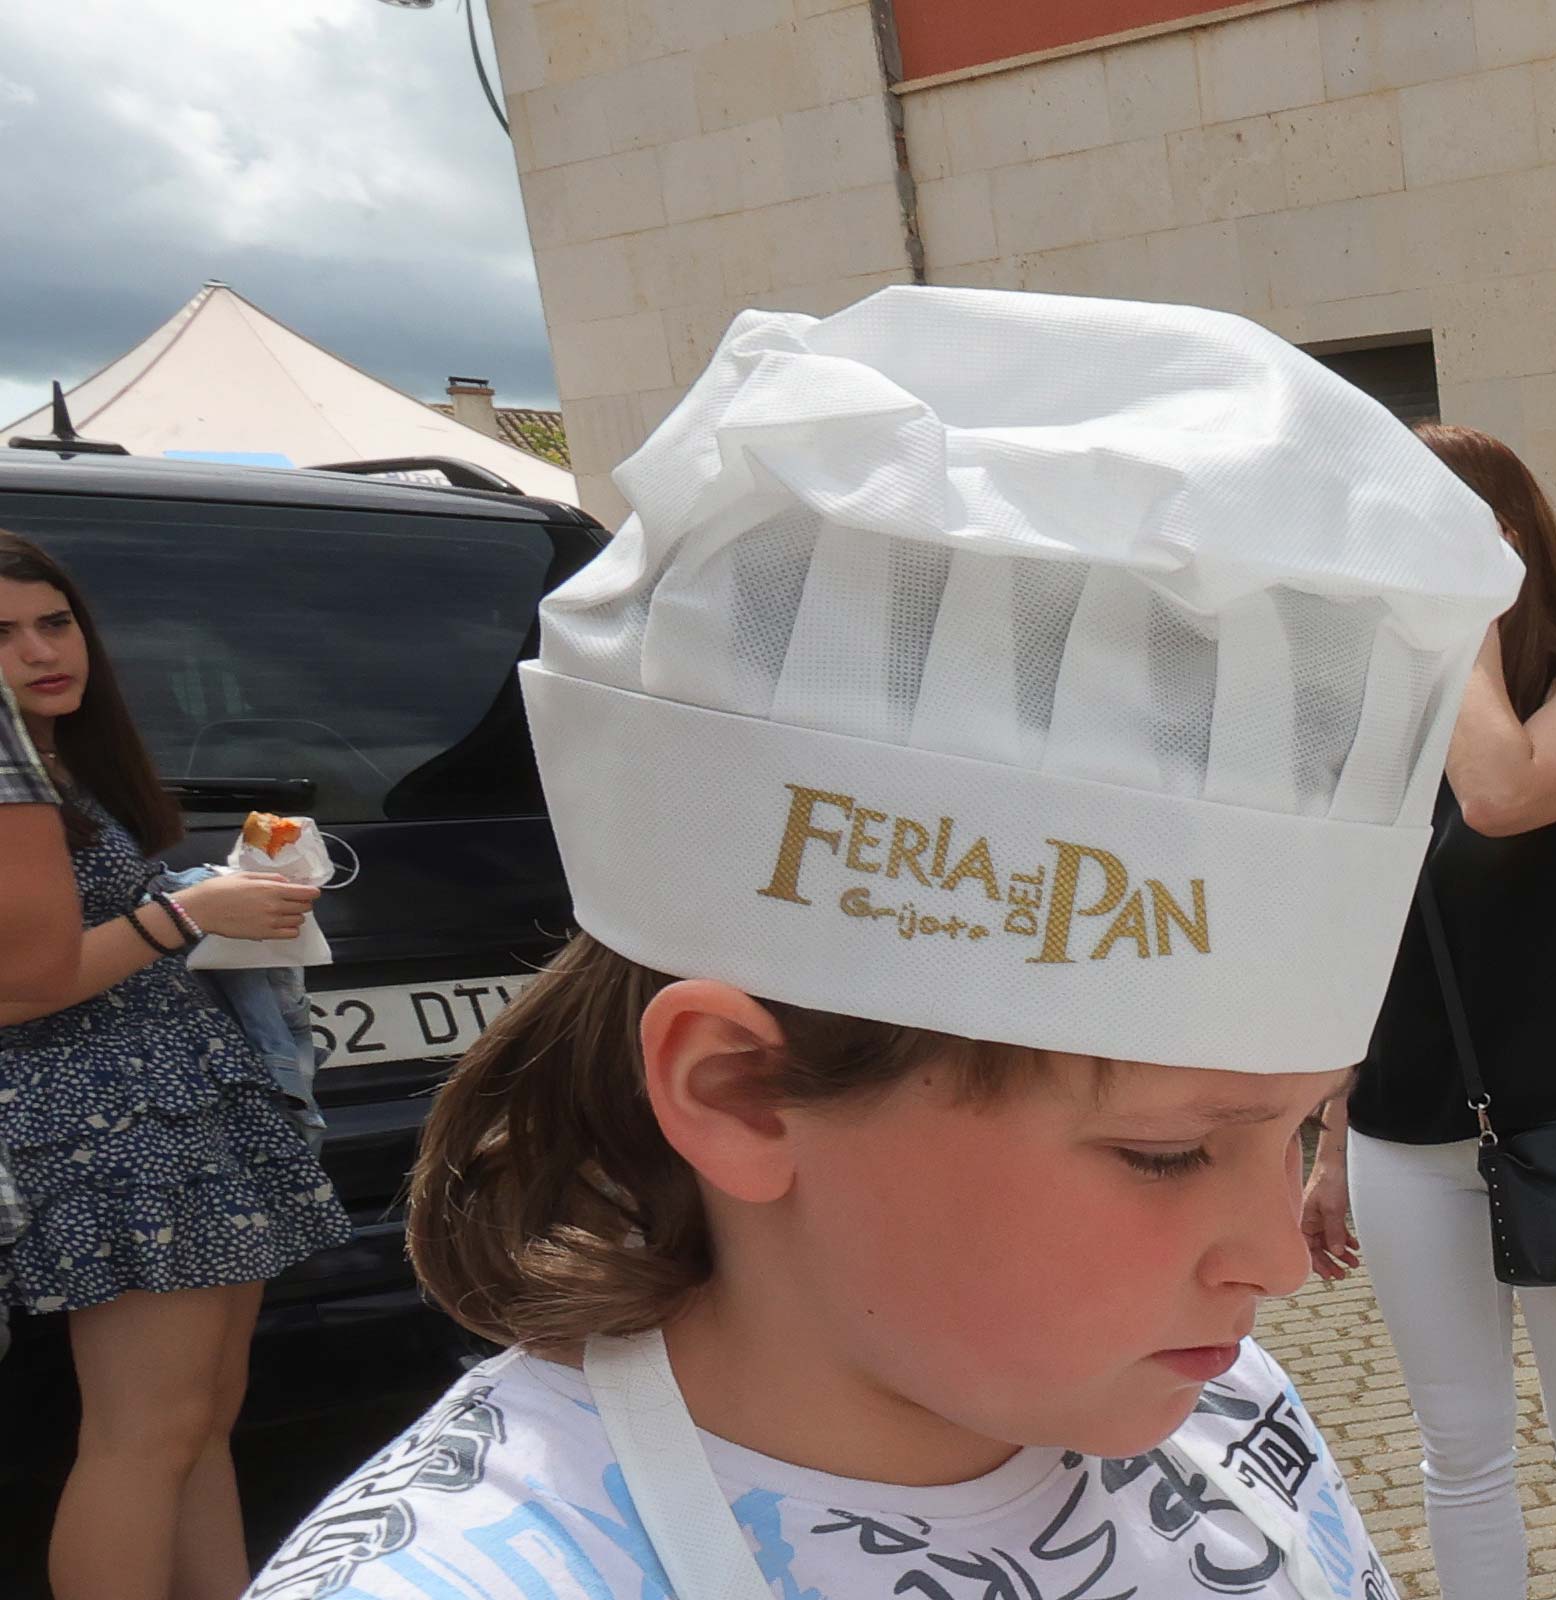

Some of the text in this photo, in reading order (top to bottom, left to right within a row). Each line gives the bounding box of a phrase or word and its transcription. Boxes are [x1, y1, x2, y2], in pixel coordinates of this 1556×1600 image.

[756, 783, 1212, 964] FERIA DEL PAN
